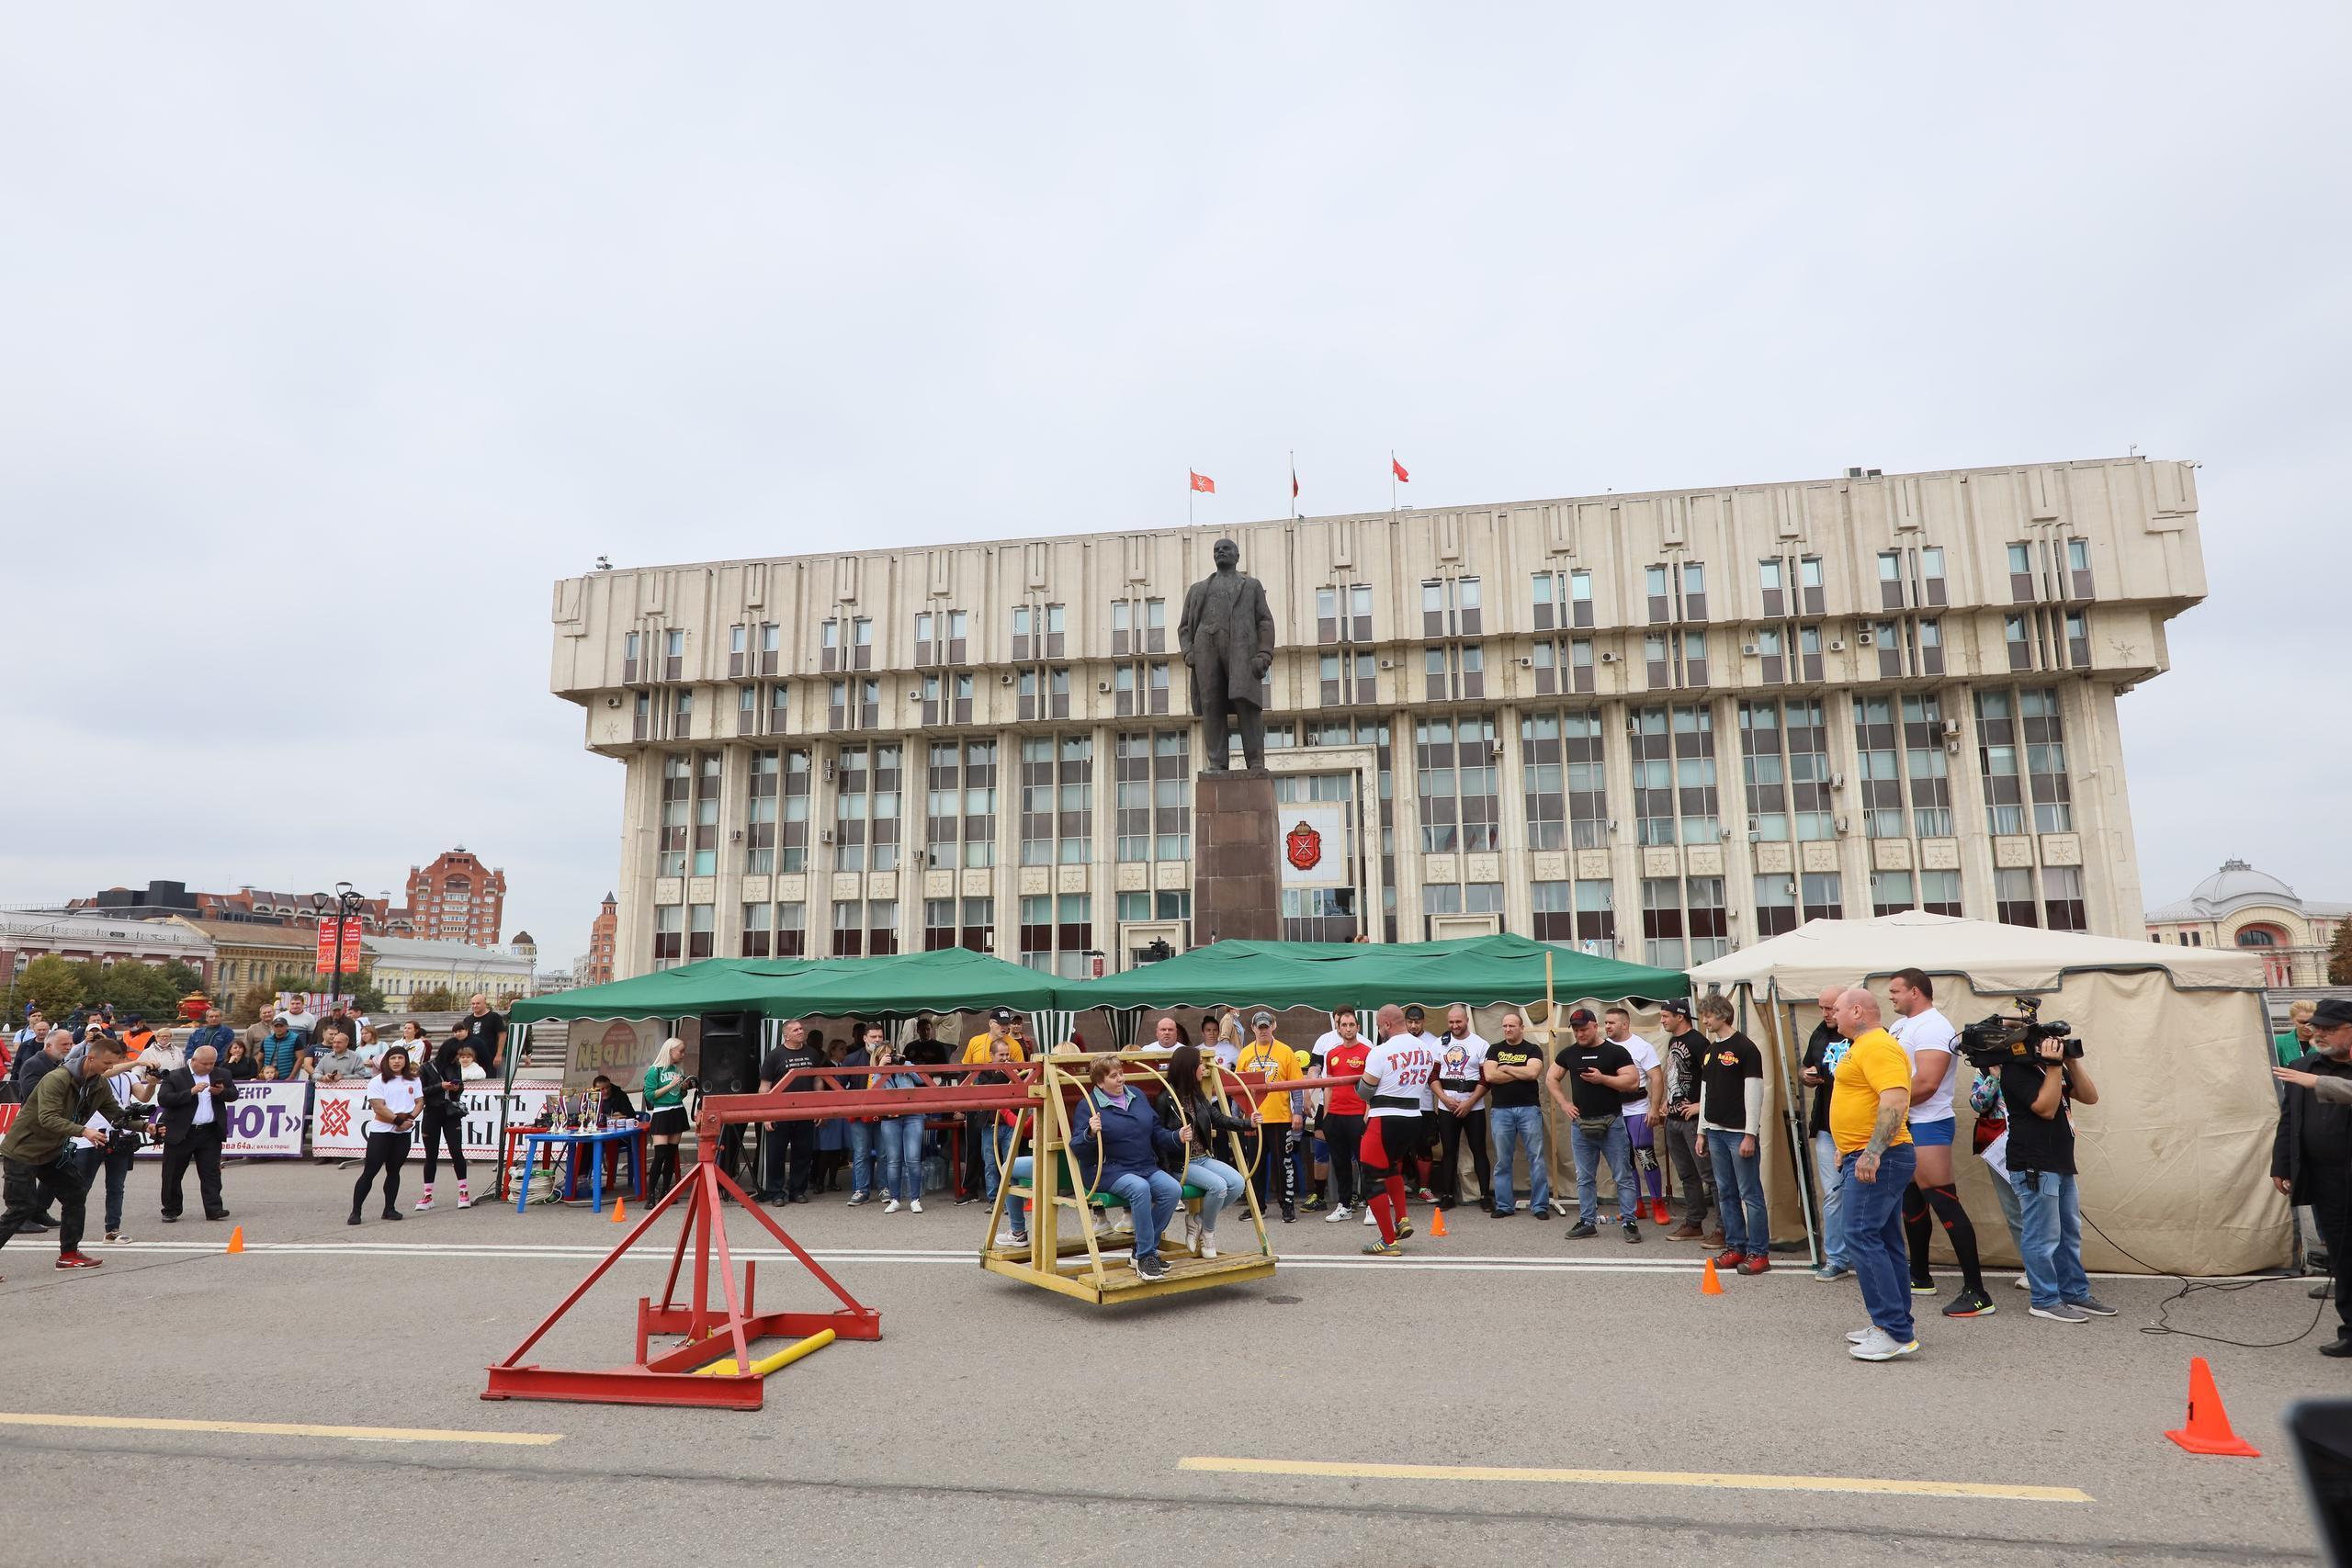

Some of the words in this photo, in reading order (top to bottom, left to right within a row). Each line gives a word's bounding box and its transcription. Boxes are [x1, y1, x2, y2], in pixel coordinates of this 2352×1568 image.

[1387, 1049, 1434, 1071] ТУЛА
[1398, 1068, 1427, 1087] 875
[237, 1087, 272, 1099] ЕНТР
[226, 1104, 301, 1139] ЮТ»
[2188, 1401, 2195, 1422] 1
